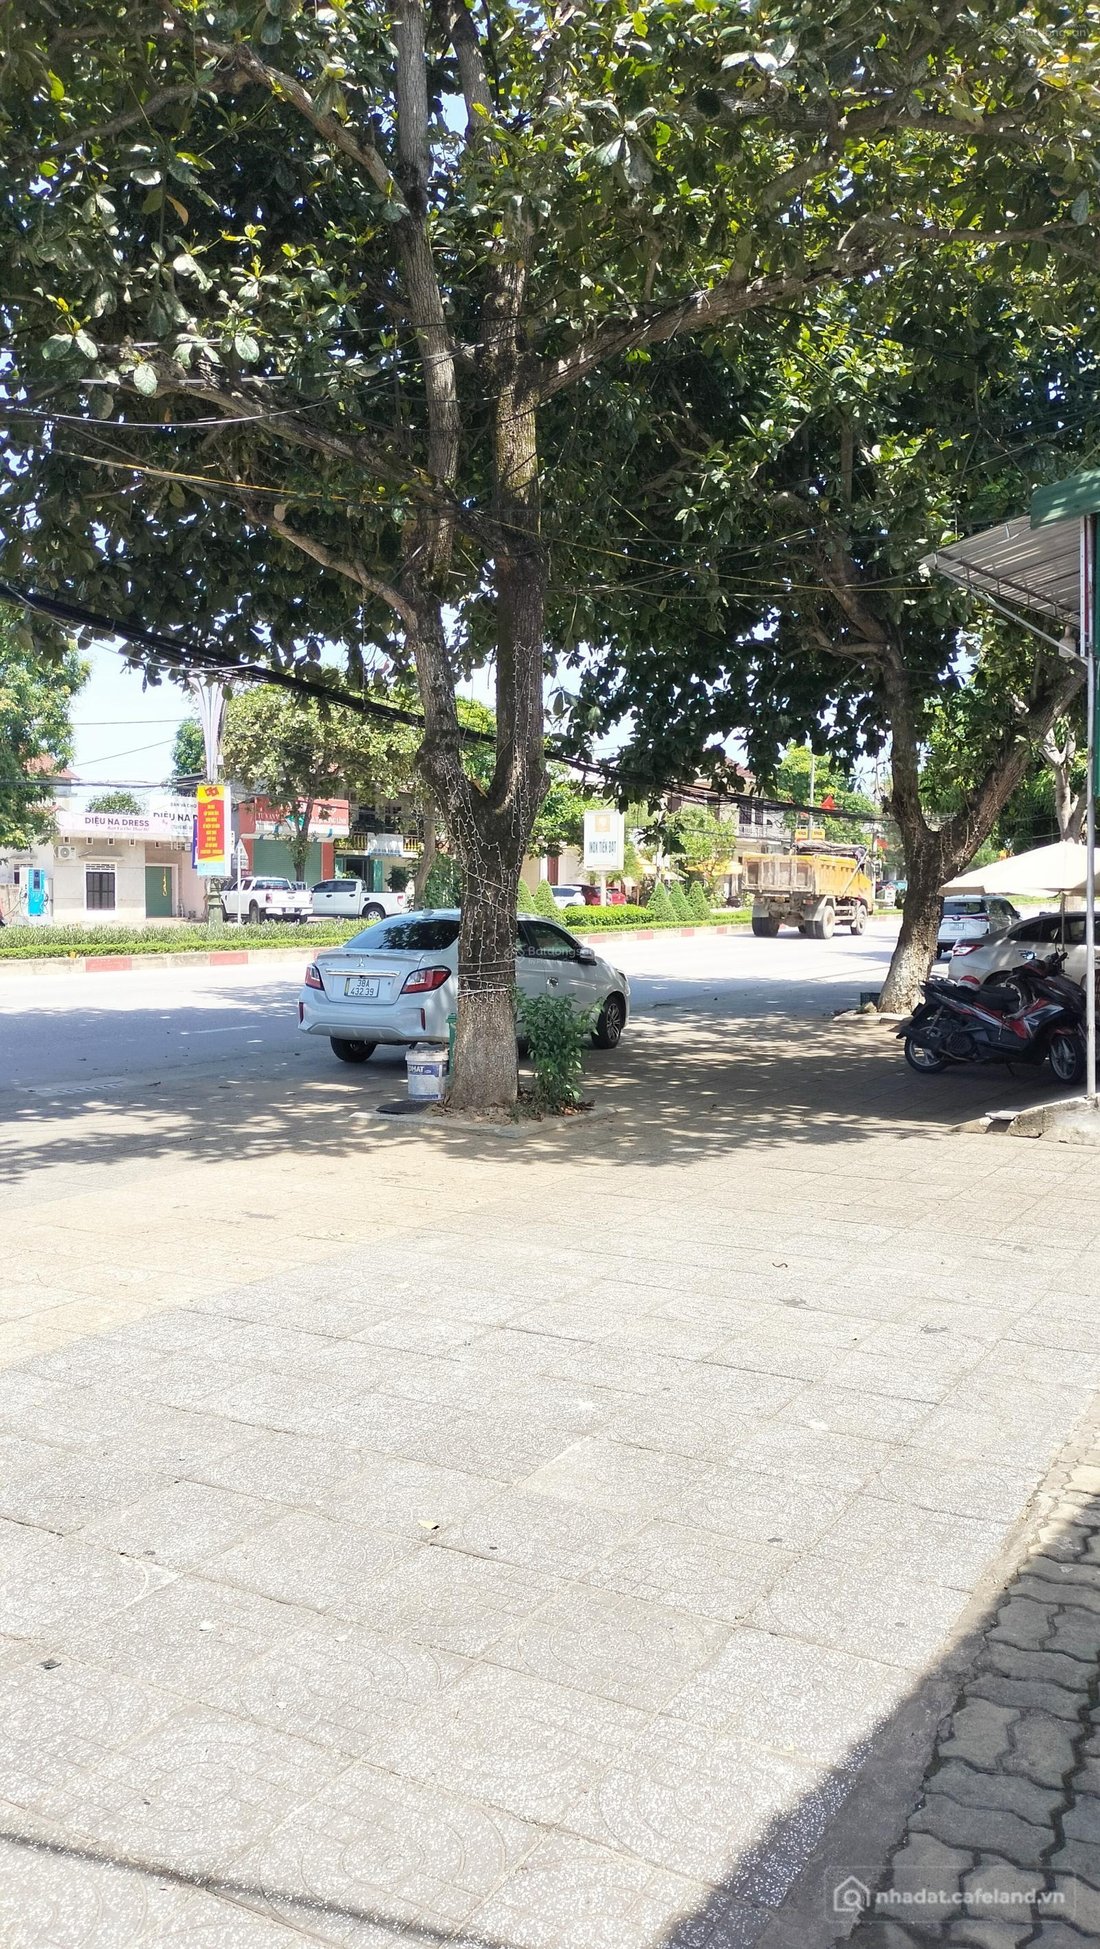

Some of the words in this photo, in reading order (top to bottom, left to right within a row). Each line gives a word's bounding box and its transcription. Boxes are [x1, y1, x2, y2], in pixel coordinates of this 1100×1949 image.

[84, 816, 106, 827] DIỆU
[107, 818, 120, 826] NA
[122, 819, 150, 827] DRESS
[178, 814, 191, 822] NA
[357, 979, 370, 988] 38A
[350, 987, 375, 996] 432.39
